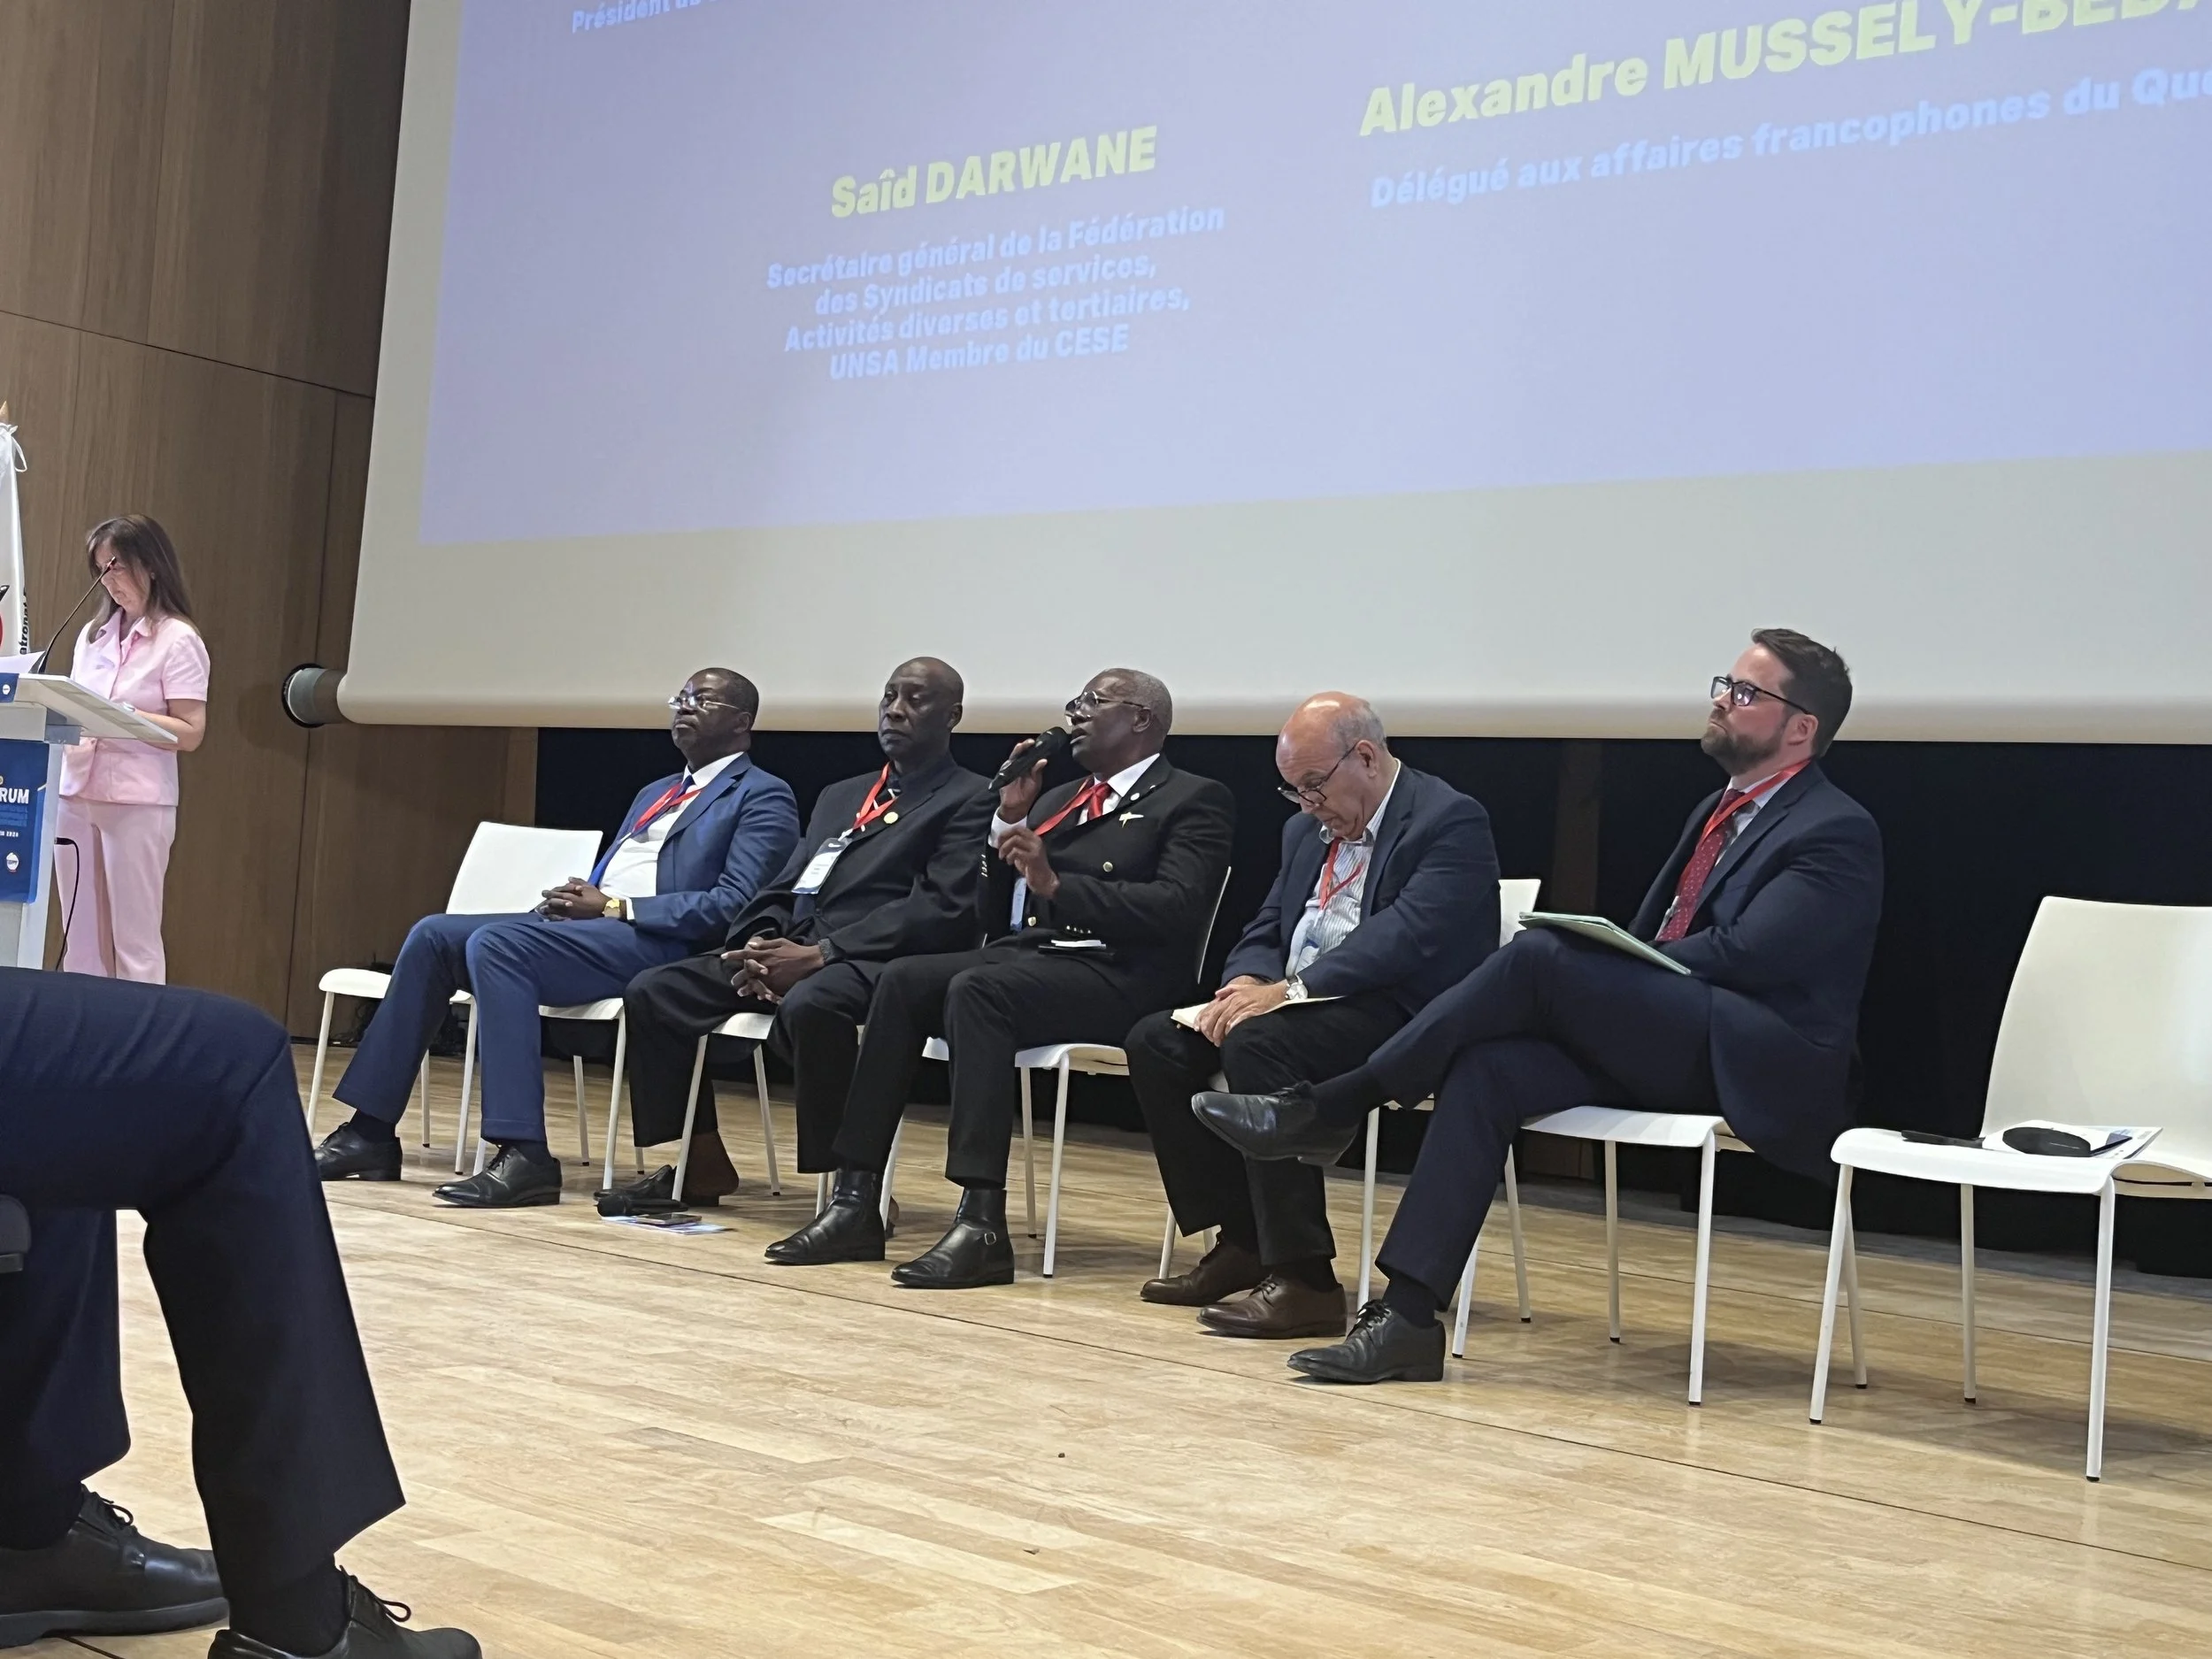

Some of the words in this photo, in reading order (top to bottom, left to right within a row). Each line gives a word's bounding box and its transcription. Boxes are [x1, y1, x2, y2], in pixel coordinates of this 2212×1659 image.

[1359, 53, 1648, 136] Alexandre
[926, 125, 1157, 204] DARWANE
[1371, 157, 1509, 208] Délégué
[1517, 156, 1584, 188] aux
[1591, 135, 1744, 178] affaires
[1751, 90, 2051, 157] francophones
[2062, 77, 2120, 116] du
[766, 250, 893, 288] Secrétaire
[898, 232, 995, 277] général
[999, 230, 1032, 258] de
[1038, 224, 1063, 254] la
[1068, 204, 1225, 250] Fédération
[815, 288, 857, 316] des
[864, 270, 988, 314] Syndicats
[995, 266, 1026, 295] de
[1032, 253, 1156, 290] services,
[784, 315, 895, 352] Activités
[899, 308, 1008, 339] diverses
[1015, 299, 1041, 326] et
[1048, 285, 1190, 323] tertiaires,
[829, 348, 900, 380] UNSA
[905, 340, 1010, 373] Membre
[1017, 333, 1048, 363] du
[1055, 323, 1130, 358] CESE
